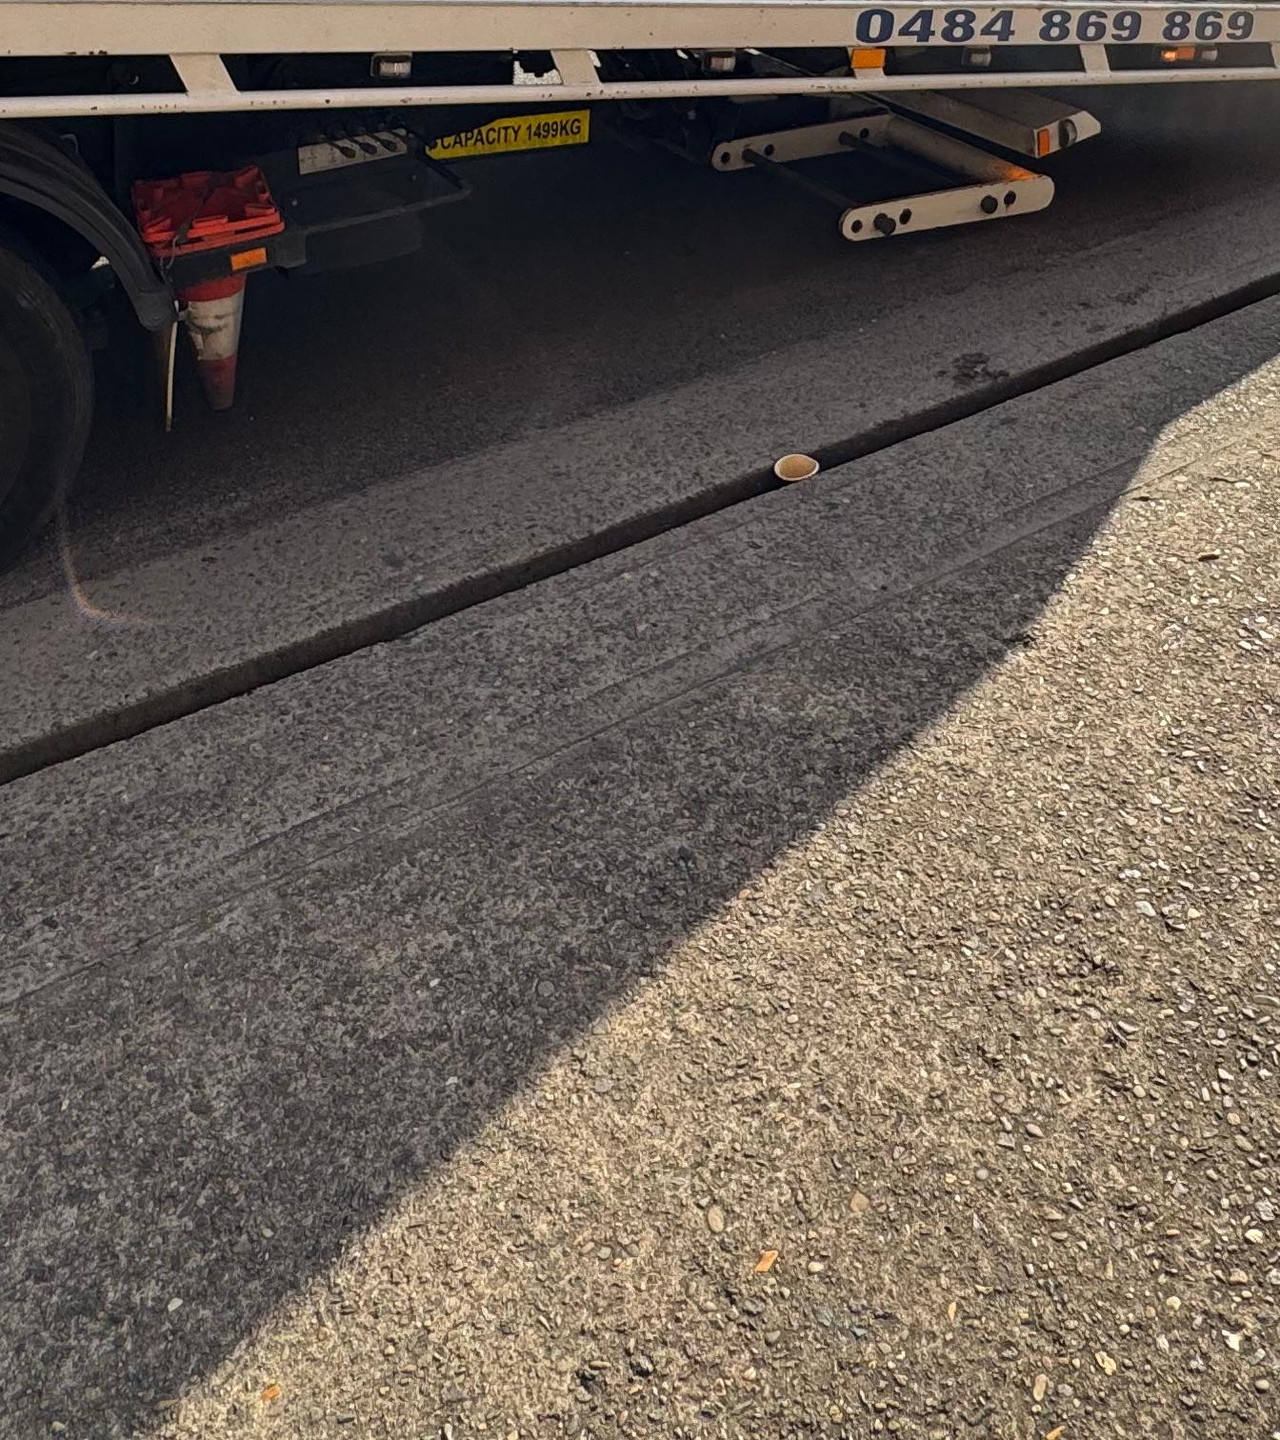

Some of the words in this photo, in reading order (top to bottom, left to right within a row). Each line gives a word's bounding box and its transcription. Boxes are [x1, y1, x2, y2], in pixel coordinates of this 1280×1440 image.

[855, 9, 1016, 44] 0484
[1038, 10, 1143, 43] 869
[1162, 10, 1255, 41] 869
[440, 125, 521, 150] CAPACITY
[526, 118, 582, 141] 1499KG
